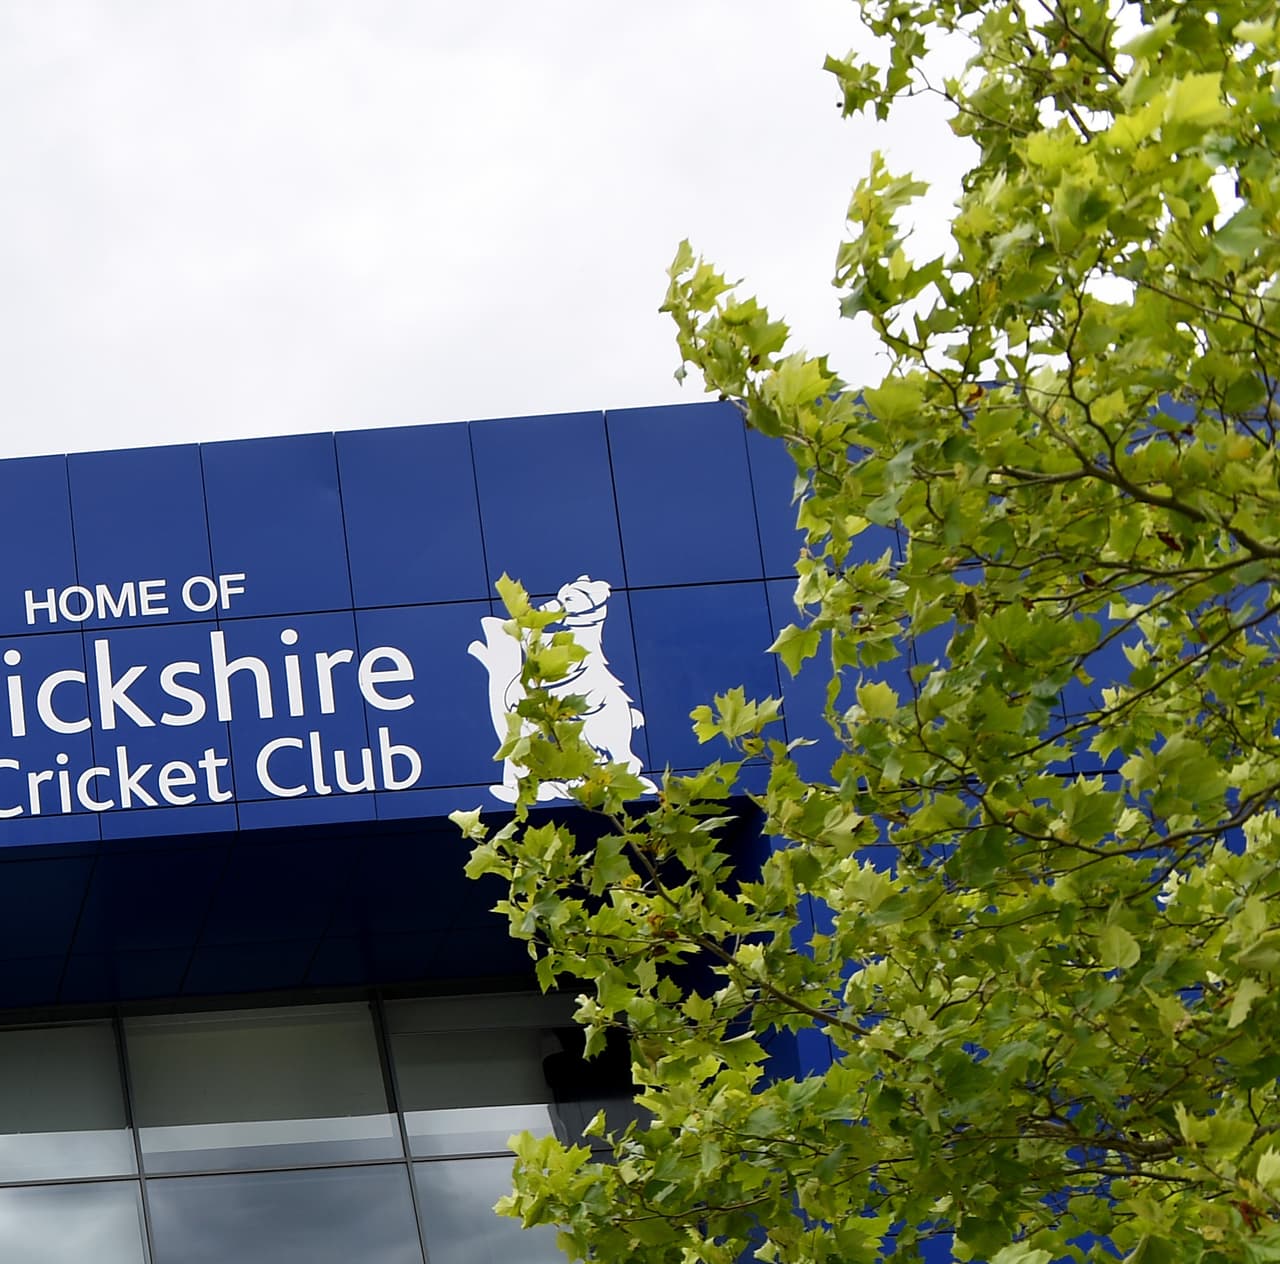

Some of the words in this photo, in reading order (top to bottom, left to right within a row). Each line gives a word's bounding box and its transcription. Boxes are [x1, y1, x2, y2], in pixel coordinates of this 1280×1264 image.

[25, 579, 168, 625] HOME
[182, 573, 246, 612] OF
[257, 726, 422, 798] Club
